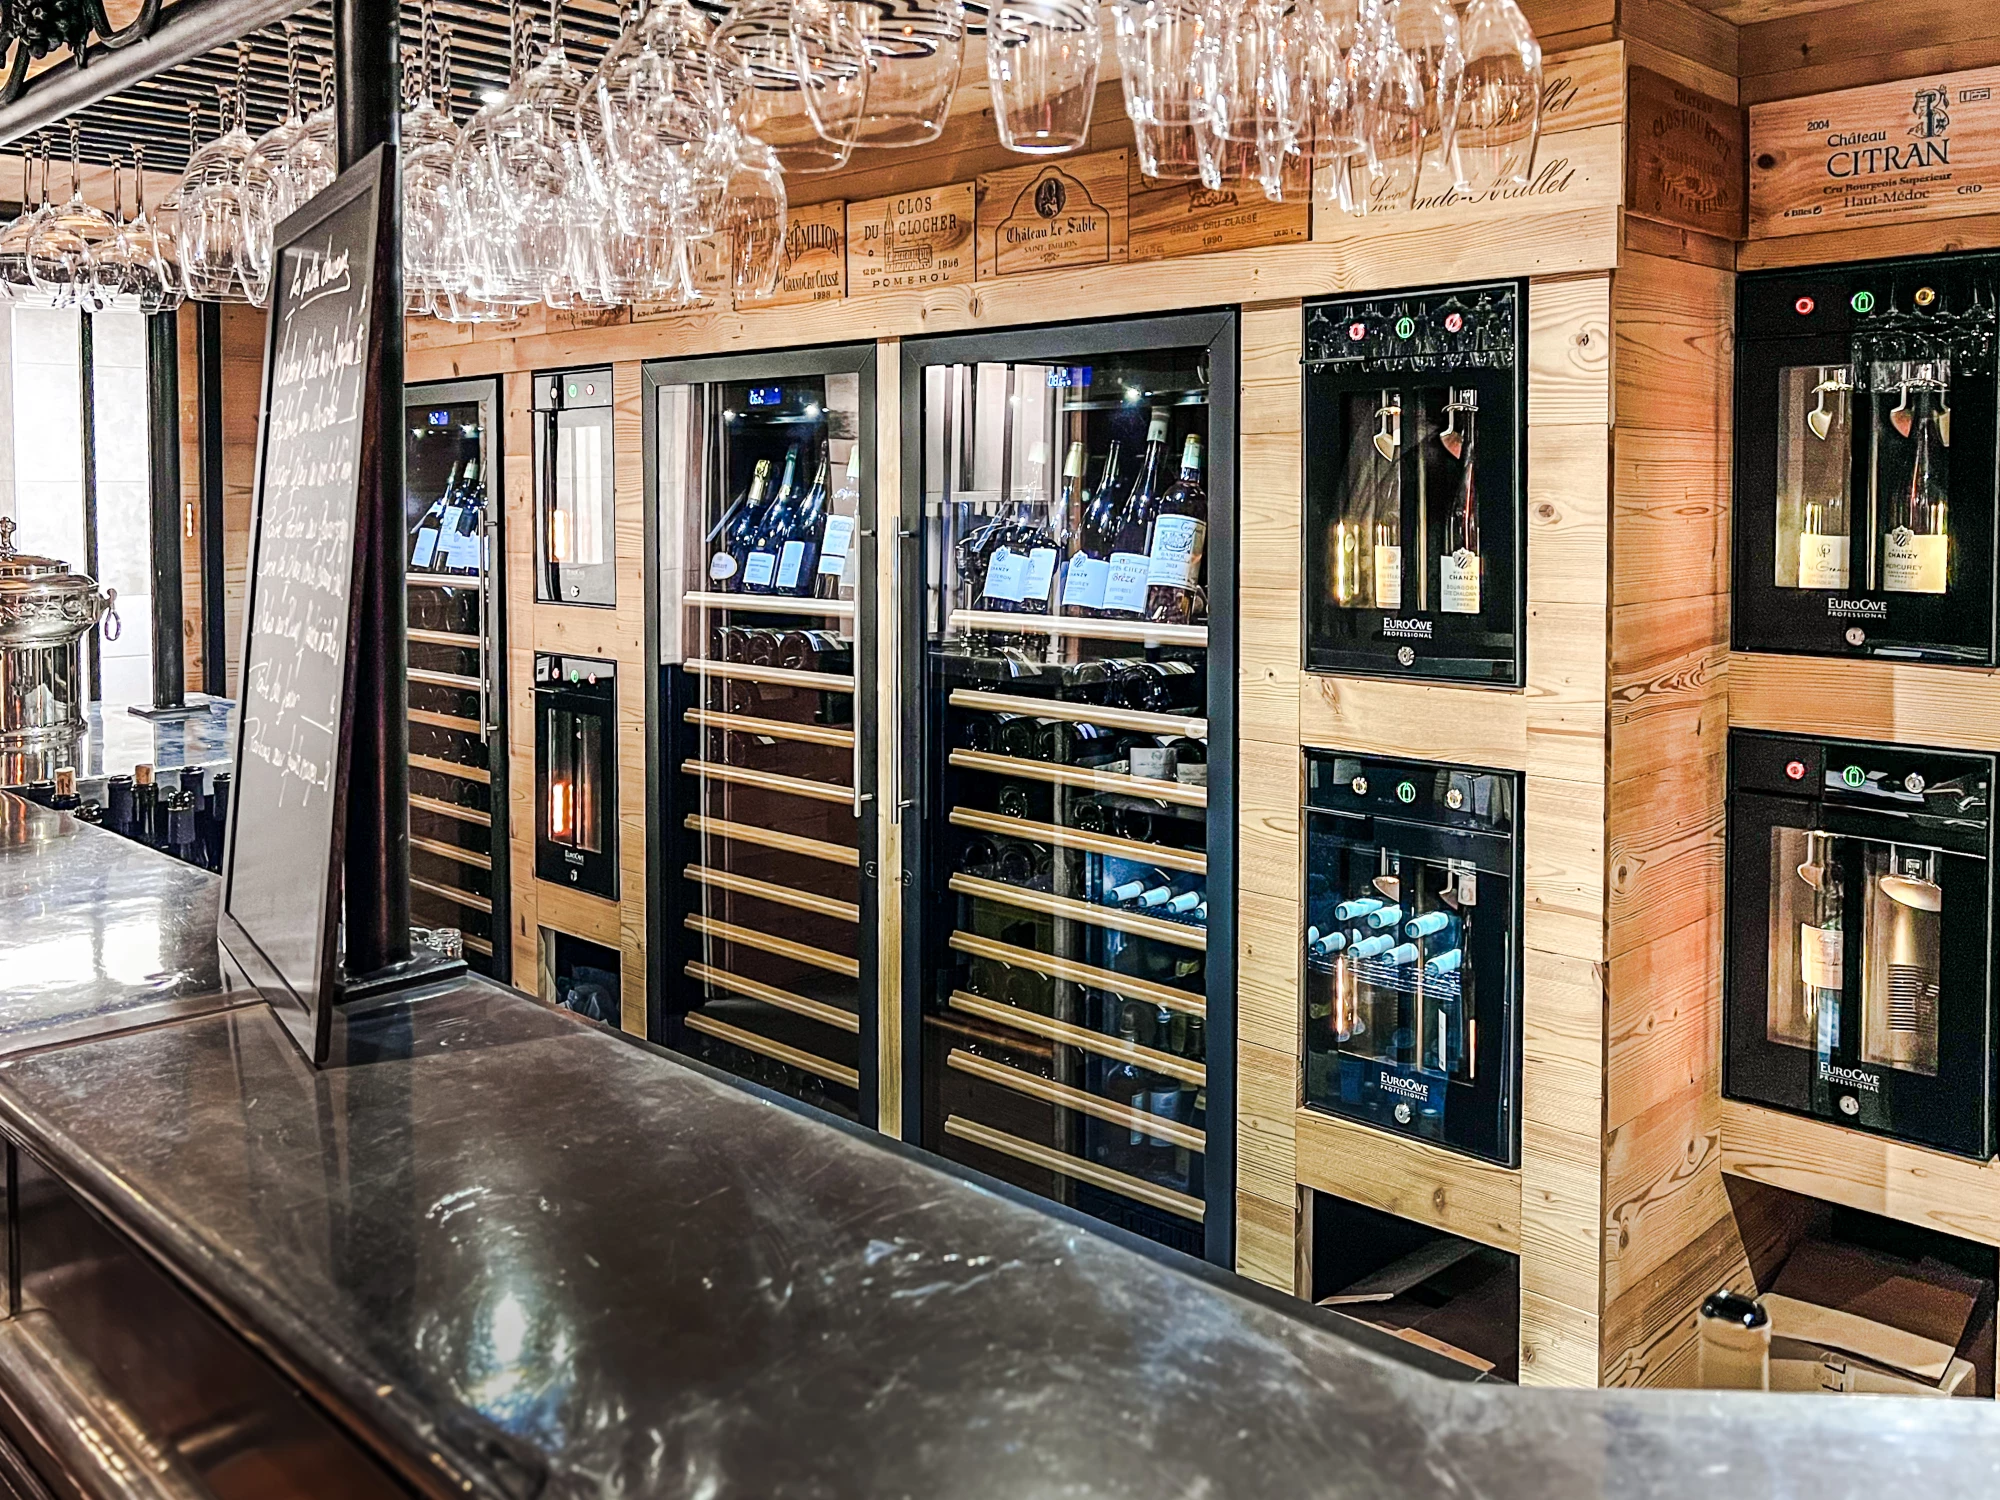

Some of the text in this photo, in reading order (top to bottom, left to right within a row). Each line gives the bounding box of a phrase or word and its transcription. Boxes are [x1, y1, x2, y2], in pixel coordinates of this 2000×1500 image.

[1807, 120, 1830, 131] 2004
[1827, 131, 1887, 147] Château
[1827, 138, 1950, 178] CITRAN
[1823, 186, 1843, 194] Cru
[1845, 178, 1897, 193] Bourgeois
[1957, 184, 1982, 195] CRD
[897, 197, 932, 215] CLOS
[1844, 189, 1930, 208] Haut-Médoc
[864, 213, 957, 240] DU CLOCHER
[1065, 214, 1097, 235] Sable
[1170, 222, 1199, 236] GRAND
[872, 273, 950, 288] POMEROL
[1827, 611, 1887, 619] PROFESSIONAL
[1383, 631, 1433, 639] PROFESSIONAL
[1819, 1074, 1880, 1093] PROFESSIONAL
[1380, 1085, 1428, 1102] PROFESSIONAL
